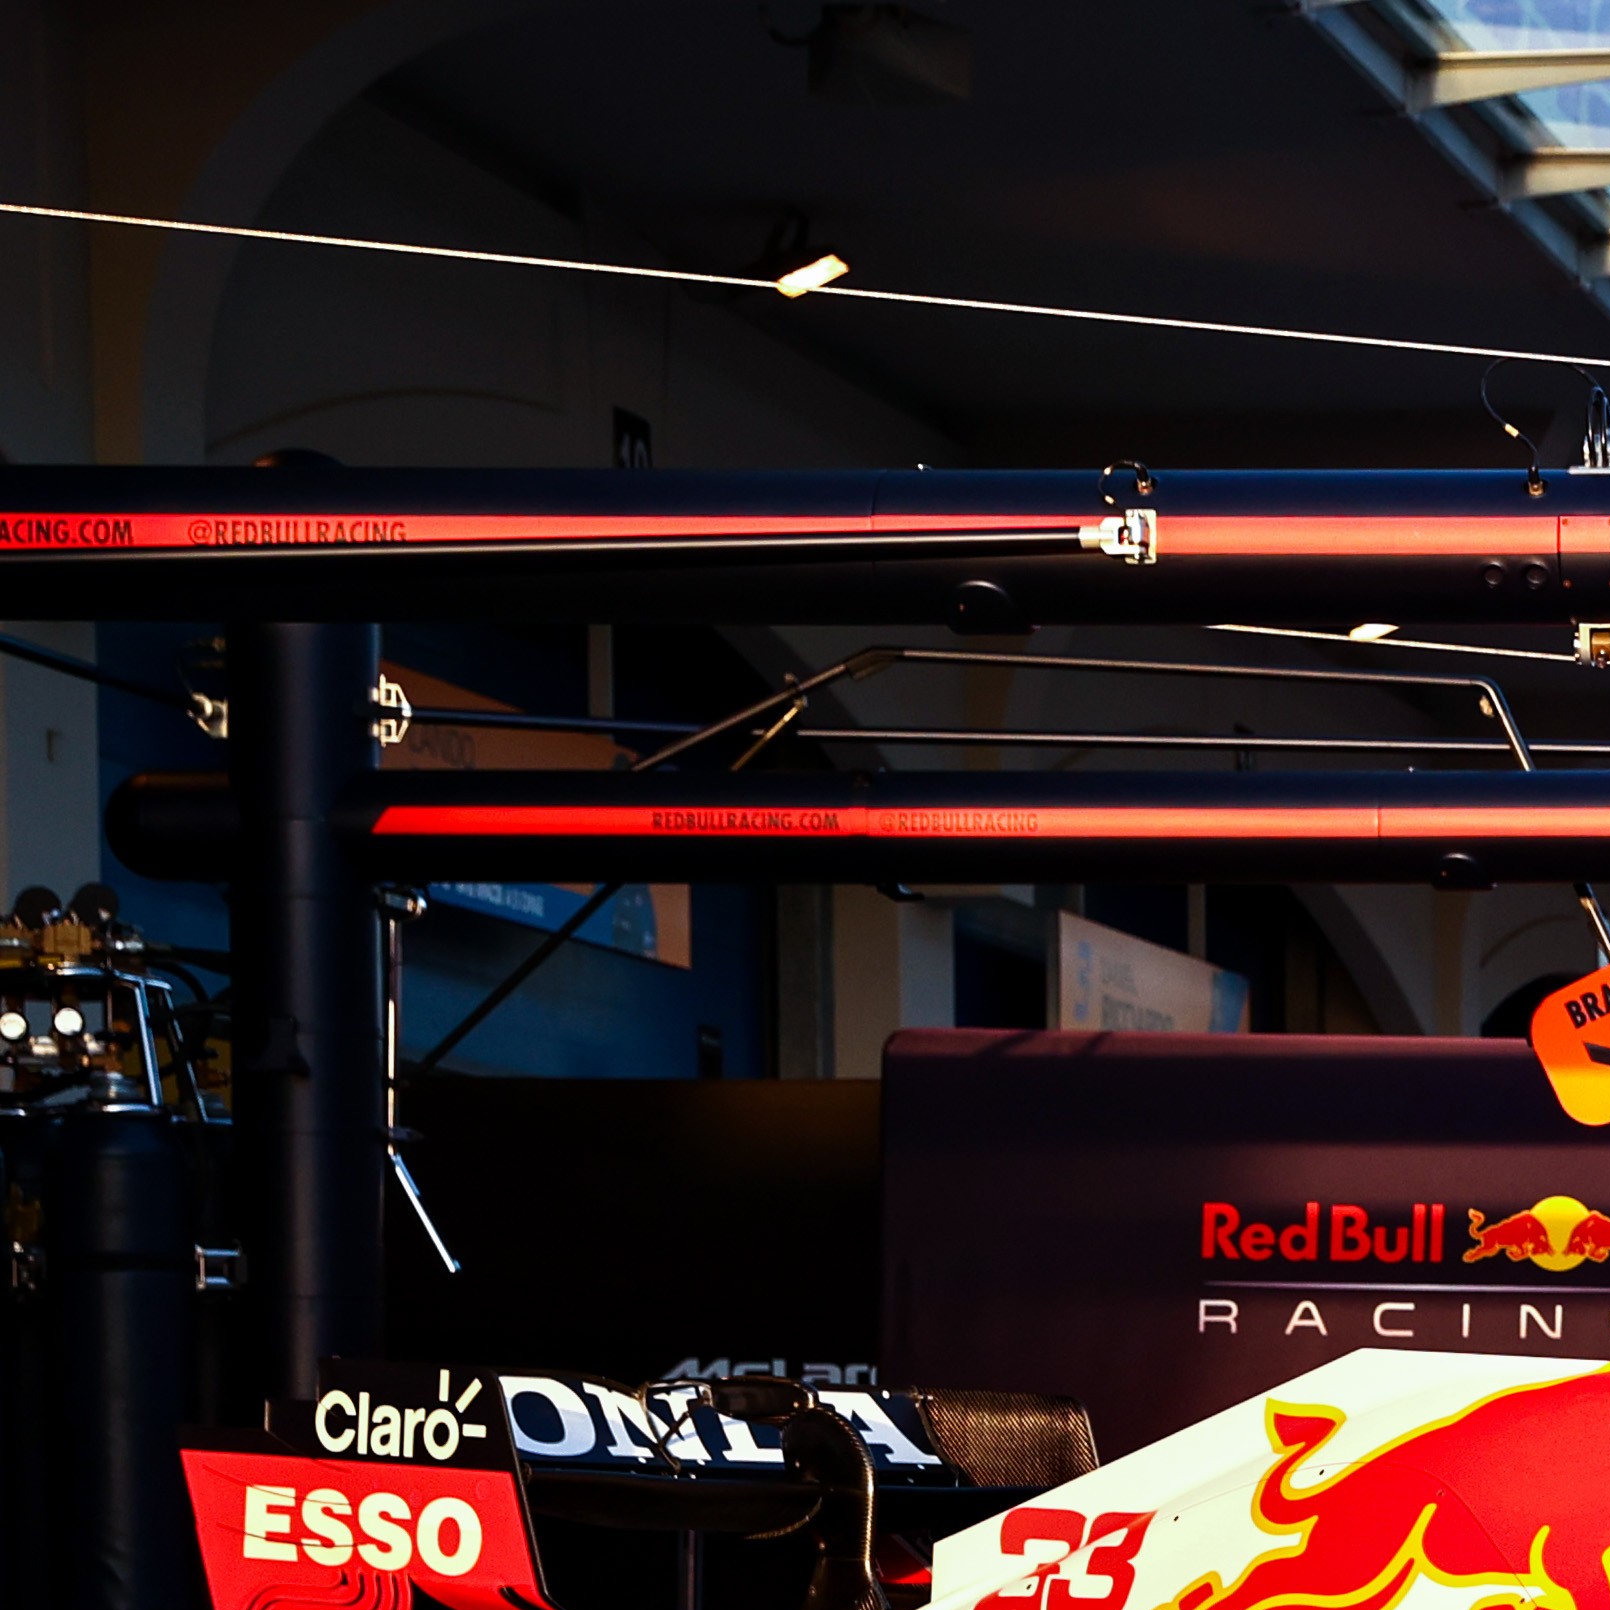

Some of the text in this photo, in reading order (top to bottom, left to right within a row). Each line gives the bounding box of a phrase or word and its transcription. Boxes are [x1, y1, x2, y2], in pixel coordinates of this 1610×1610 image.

[188, 519, 407, 546] @REDBULLRACING
[652, 812, 840, 832] REDBULLRACING.COM
[1202, 1202, 1444, 1263] Red Bull
[316, 1389, 460, 1460] Claro
[243, 1485, 483, 1577] ESSO
